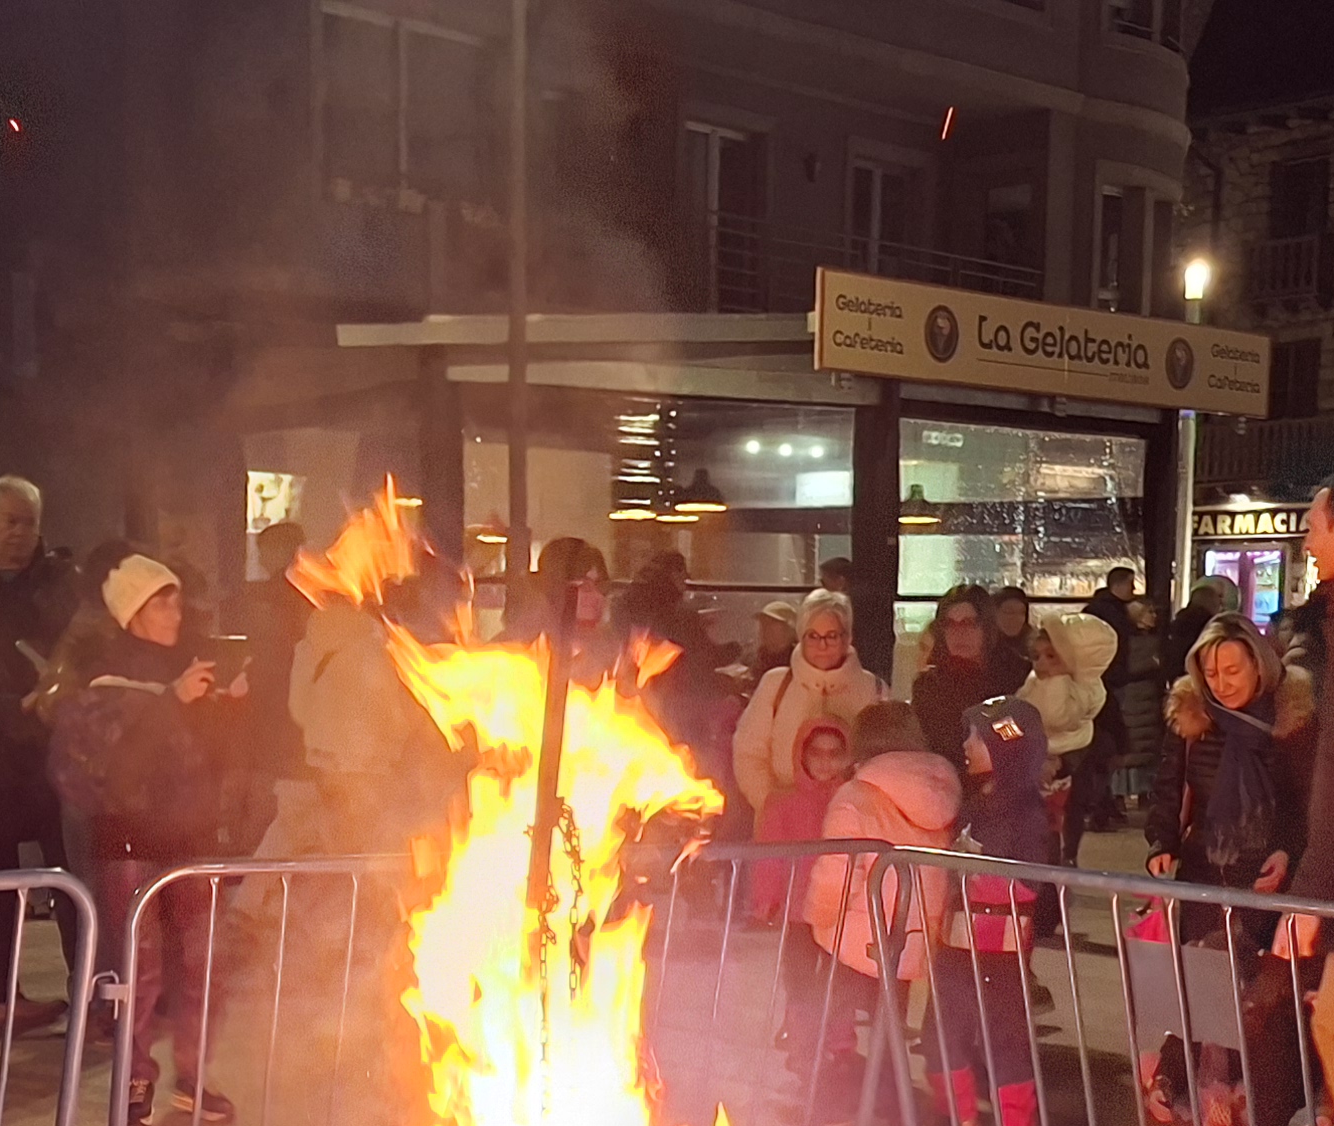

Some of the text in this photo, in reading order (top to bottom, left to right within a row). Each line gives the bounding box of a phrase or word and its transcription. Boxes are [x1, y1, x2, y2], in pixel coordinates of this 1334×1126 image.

[835, 293, 904, 319] Gelateria
[832, 329, 904, 355] Cafeteria
[978, 315, 1150, 370] La Gelateria
[1210, 343, 1260, 364] Gelateria
[1208, 374, 1261, 393] Cafeteria
